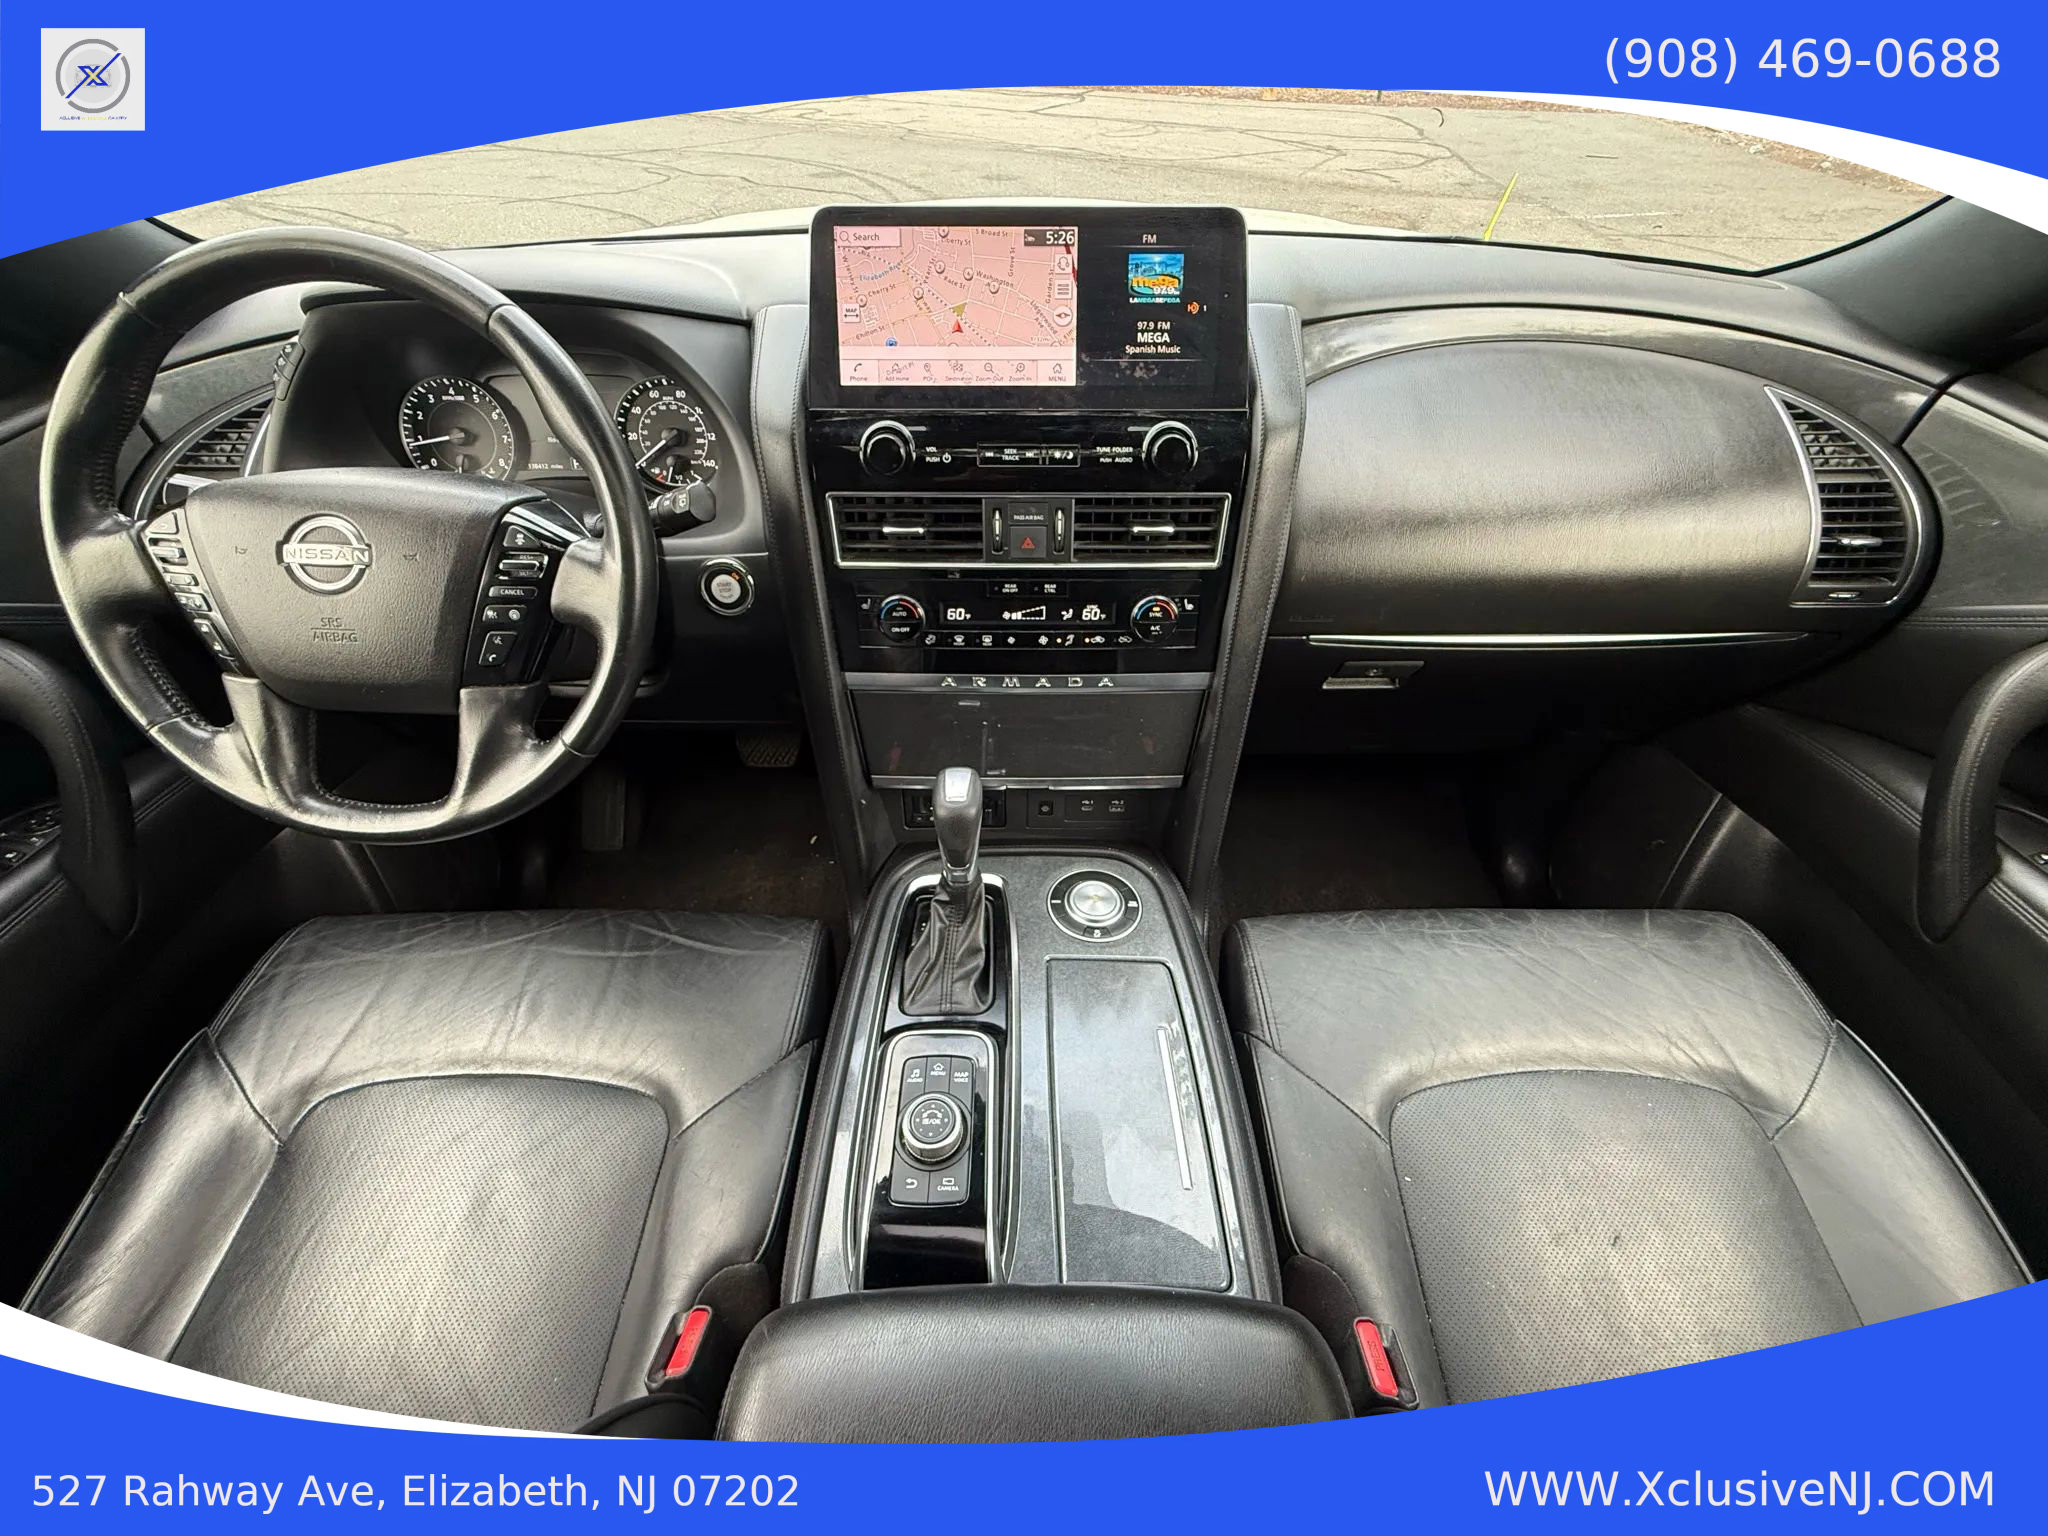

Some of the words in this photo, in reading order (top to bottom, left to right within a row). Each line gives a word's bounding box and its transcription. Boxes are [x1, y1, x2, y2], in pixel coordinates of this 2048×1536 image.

[981, 229, 1000, 237] Broad
[1046, 231, 1075, 245] 5:26
[1142, 234, 1157, 244] FM
[976, 270, 1014, 287] Washington
[868, 286, 889, 297] Cherry
[1137, 321, 1154, 330] 97.9
[1157, 321, 1171, 330] FM
[1137, 332, 1170, 343] MEGA
[1125, 345, 1157, 354] Spanish
[1157, 345, 1181, 353] Music
[449, 387, 455, 395] 4
[649, 390, 659, 398] 60
[675, 390, 686, 398] 80
[428, 394, 435, 403] 3
[473, 394, 480, 403] 5
[631, 406, 641, 414] 40
[417, 411, 423, 420] 2
[492, 411, 498, 420] 6
[502, 435, 508, 443] 7
[627, 432, 638, 440] 20
[431, 458, 437, 467] 0
[499, 458, 505, 467] 8
[285, 548, 369, 562] NISSAN
[947, 608, 965, 620] 60
[1082, 608, 1100, 620] 60
[320, 617, 343, 628] SRS
[312, 632, 358, 643] AIRBAG
[941, 676, 1114, 688] ARMADA
